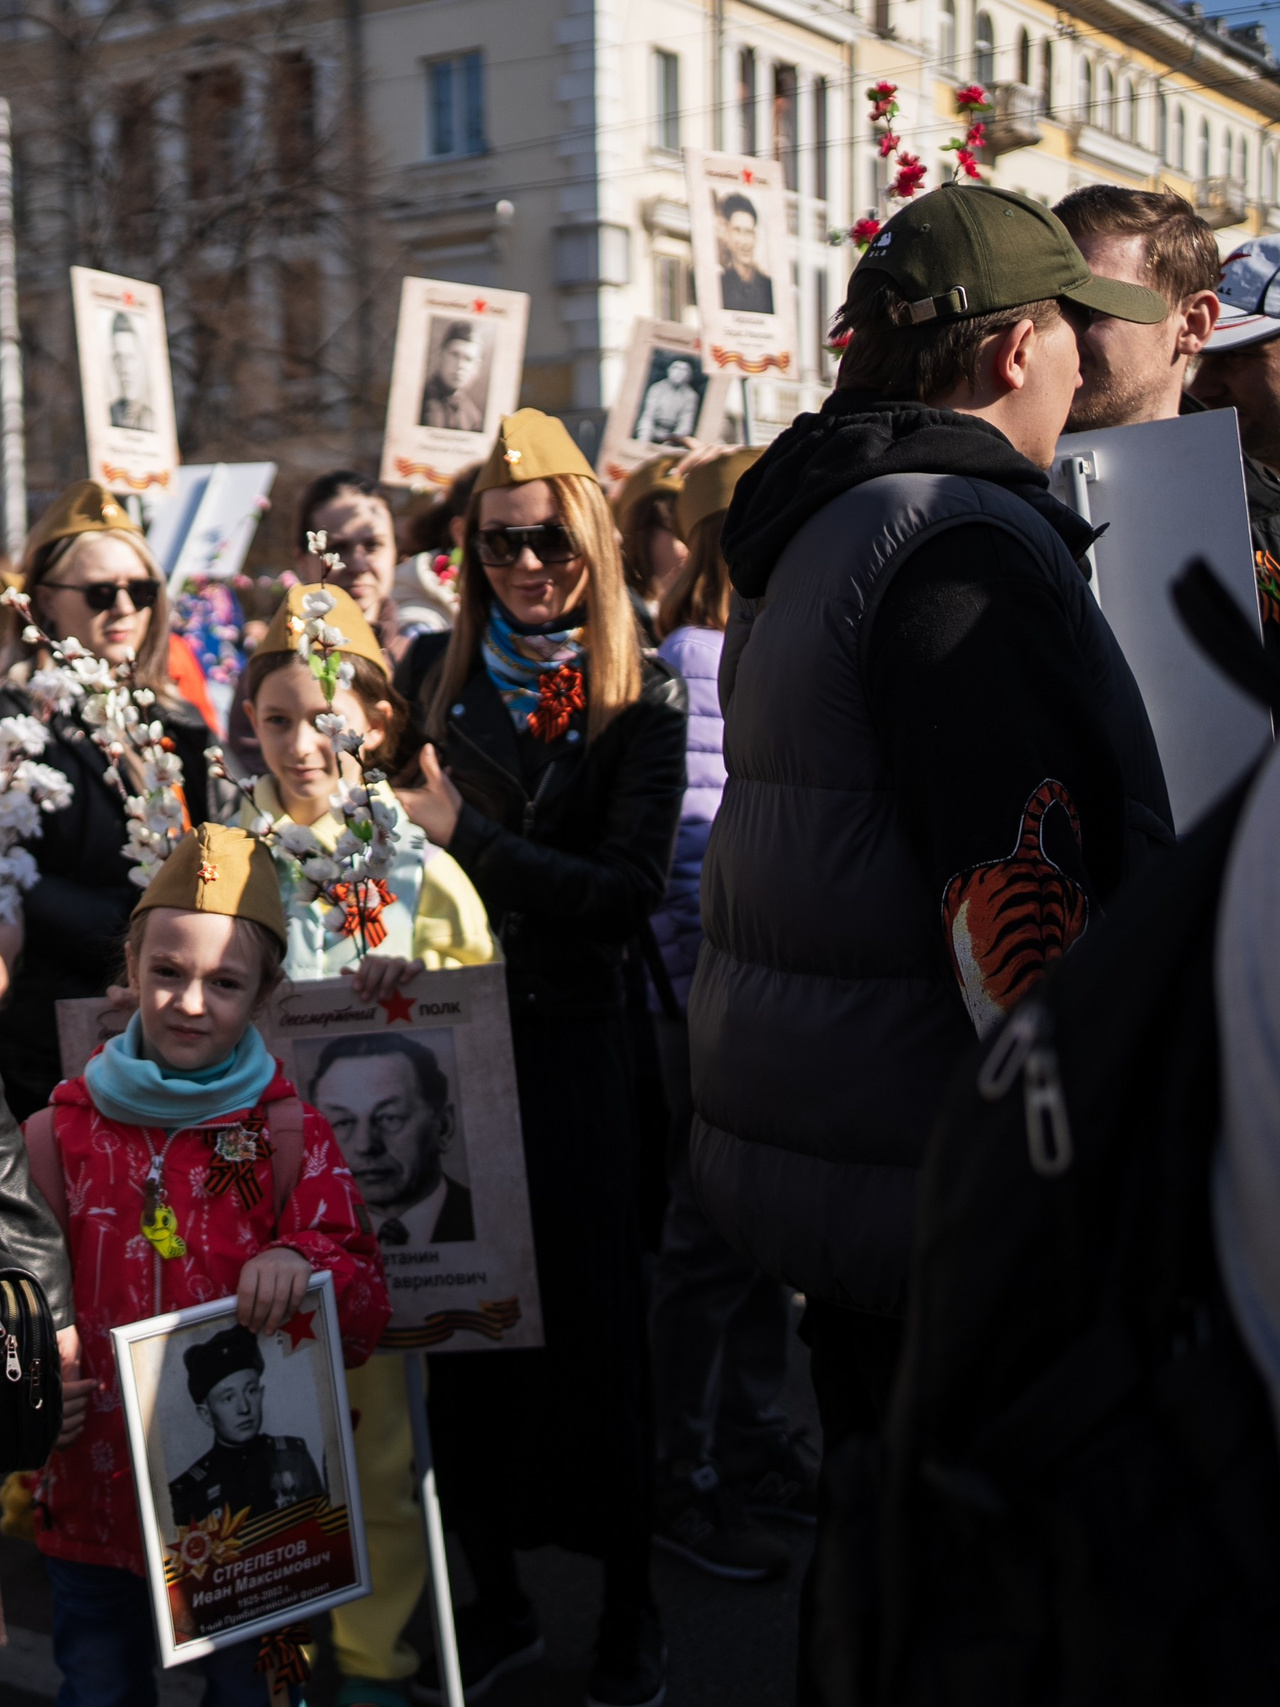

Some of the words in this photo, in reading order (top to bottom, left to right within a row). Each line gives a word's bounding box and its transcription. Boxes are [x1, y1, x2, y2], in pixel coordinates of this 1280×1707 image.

[277, 994, 377, 1028] бессмертный
[419, 1001, 461, 1016] полк
[382, 1250, 439, 1265] етанин
[192, 1586, 232, 1608] Иван
[234, 1551, 331, 1593] Максимович
[213, 1539, 307, 1583] СТРЕПЕТОВ
